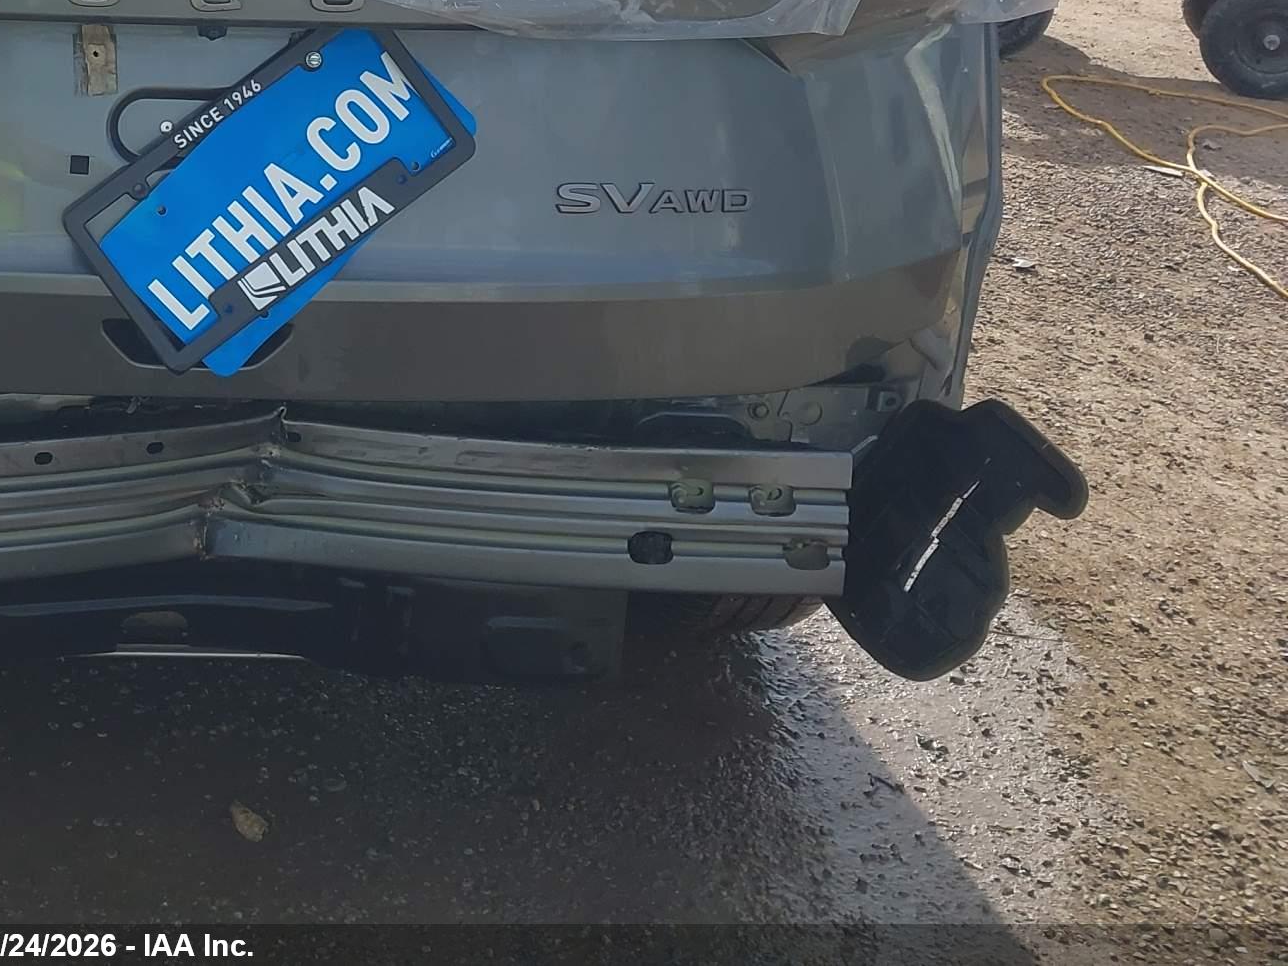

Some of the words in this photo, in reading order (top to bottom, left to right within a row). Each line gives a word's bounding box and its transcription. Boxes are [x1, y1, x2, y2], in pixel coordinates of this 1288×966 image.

[174, 106, 224, 149] SINCE
[223, 79, 262, 111] 1946
[147, 51, 423, 331] LITHIA.COM
[269, 186, 396, 287] LITHIA
